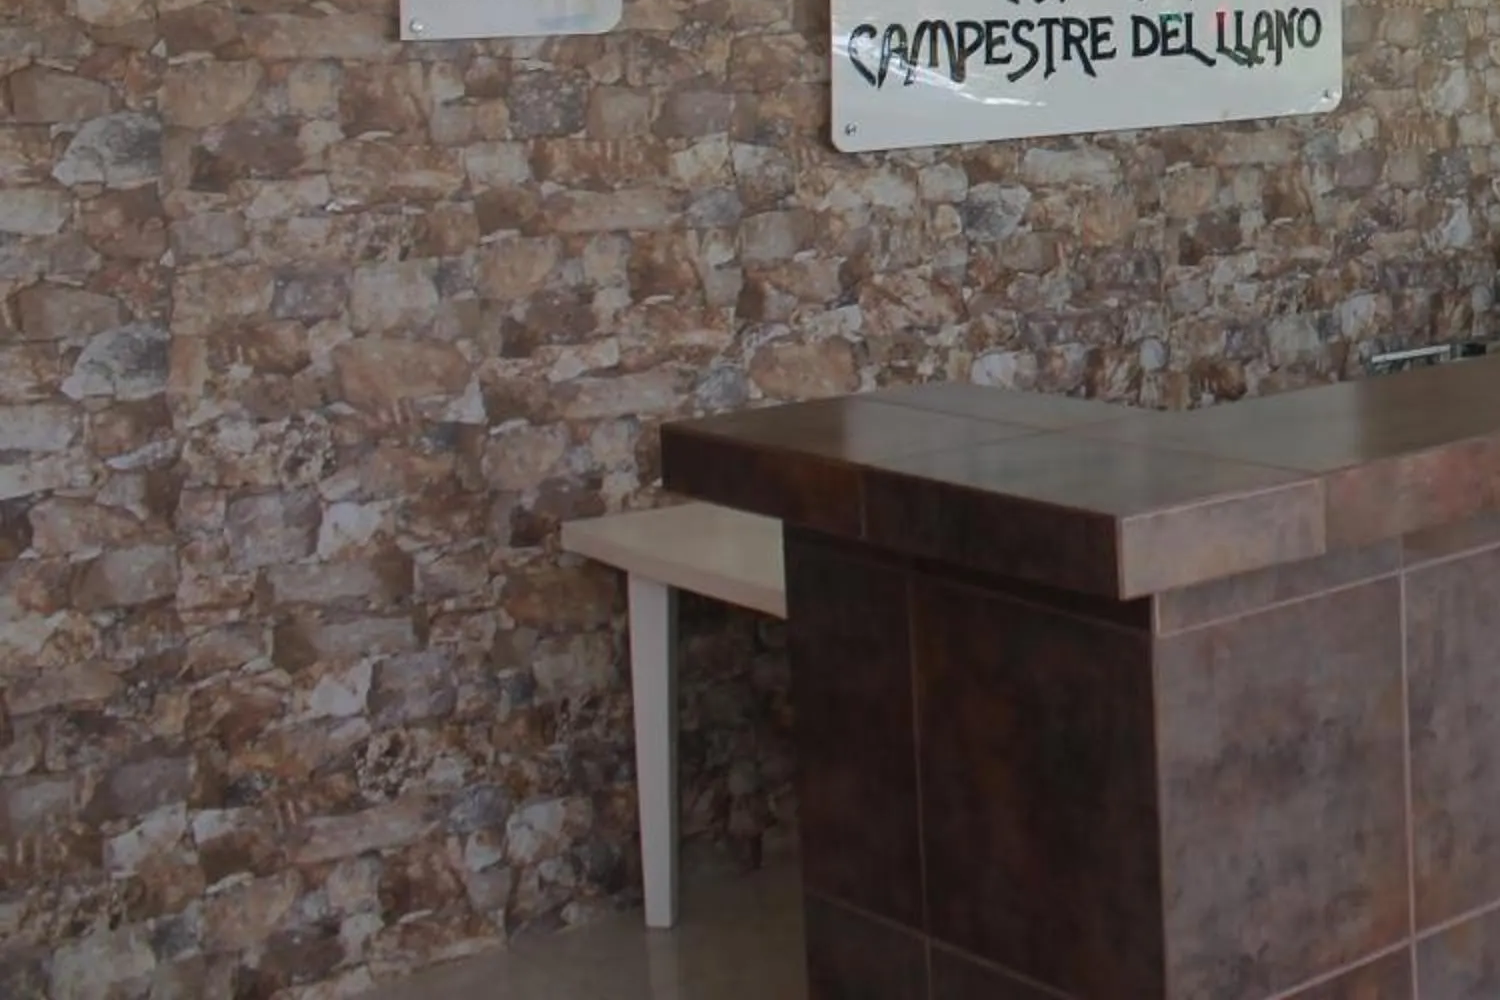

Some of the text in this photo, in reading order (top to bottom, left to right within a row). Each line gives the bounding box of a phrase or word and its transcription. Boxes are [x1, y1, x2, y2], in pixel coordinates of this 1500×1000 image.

[848, 7, 1322, 88] CAMPESTRE DEL LLANO
